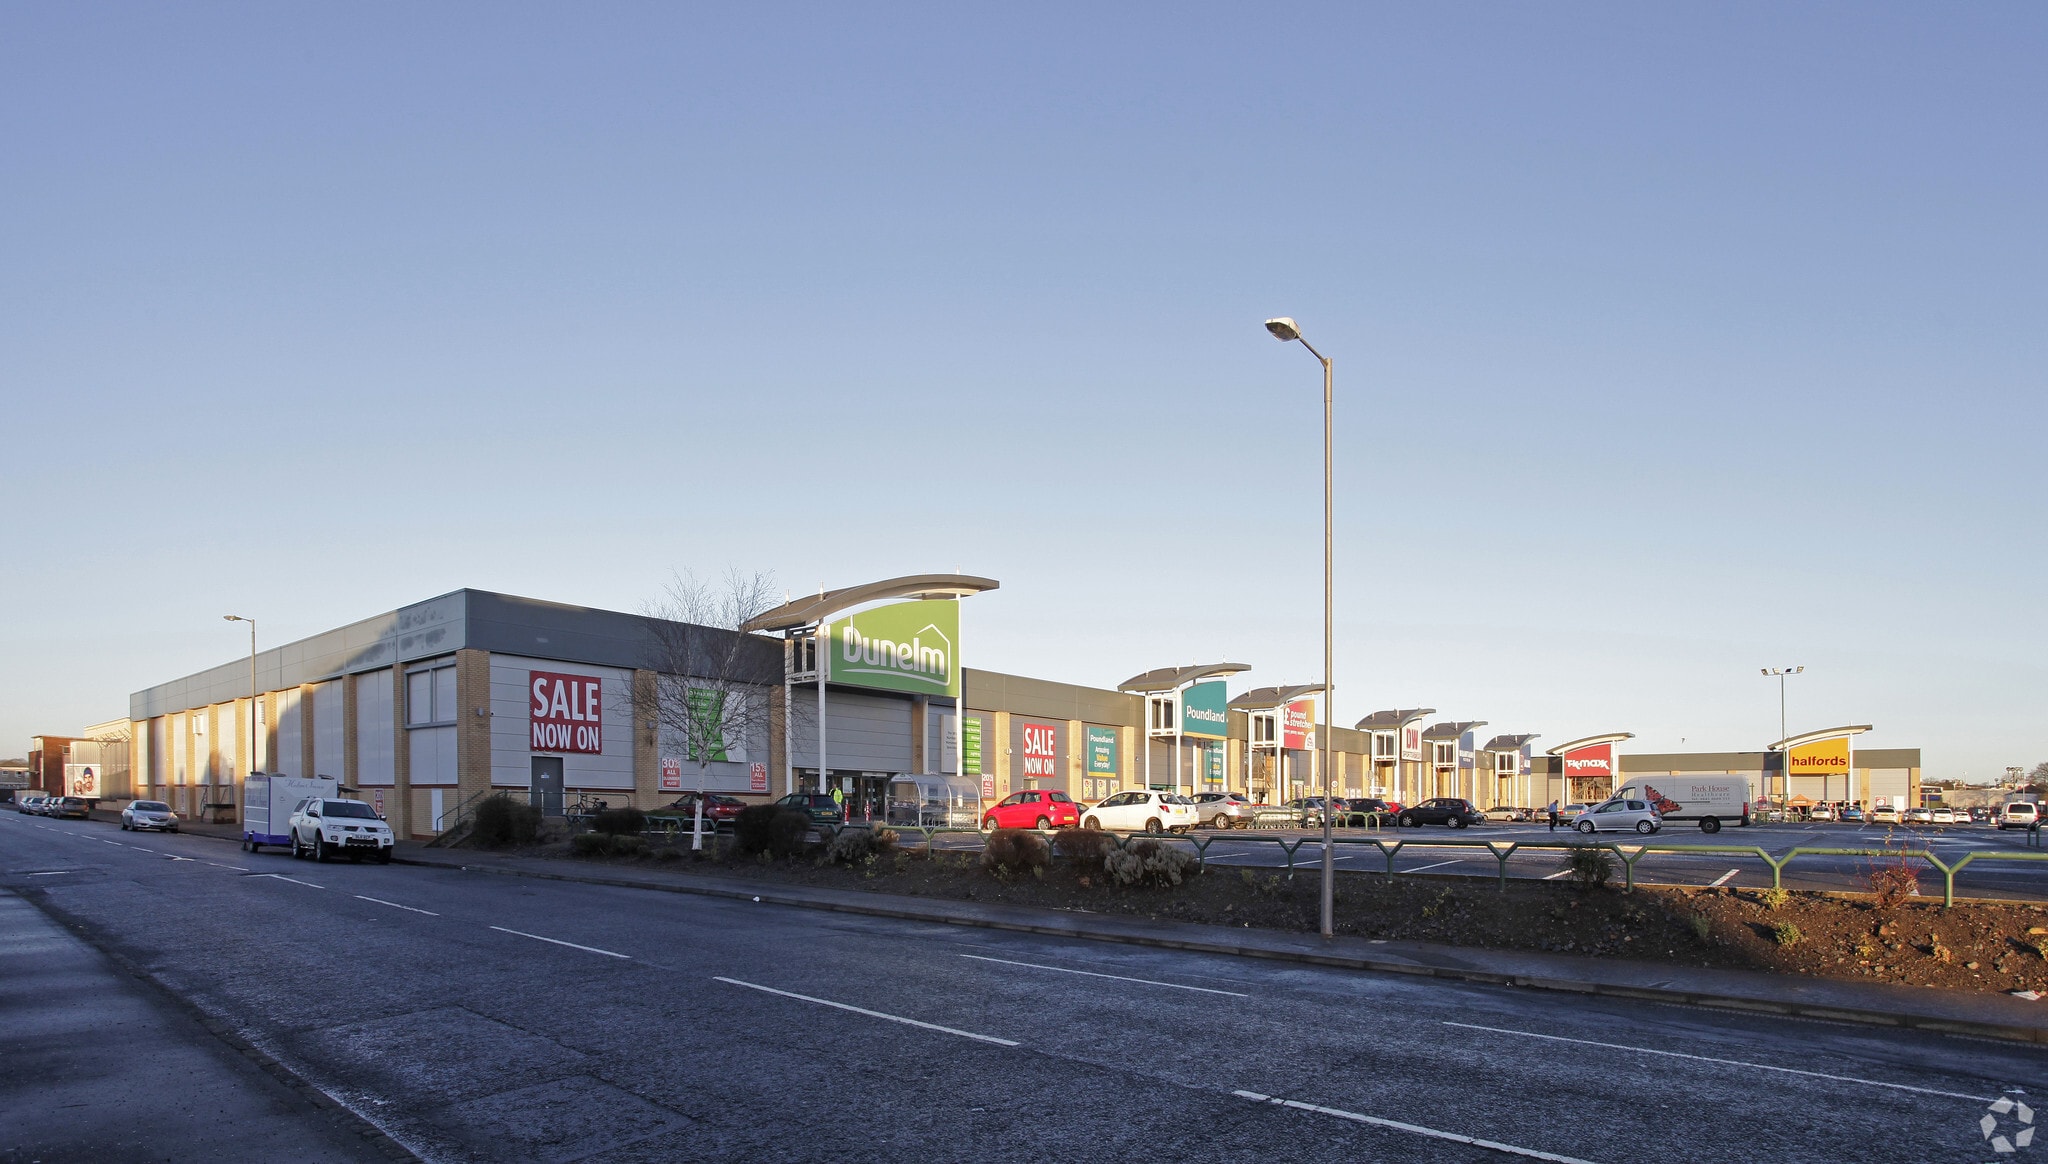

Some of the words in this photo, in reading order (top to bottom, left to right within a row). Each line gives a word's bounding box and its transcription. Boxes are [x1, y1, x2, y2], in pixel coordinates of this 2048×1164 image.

[843, 626, 945, 675] Dunelm
[533, 677, 599, 722] SALE
[1186, 705, 1225, 723] Poundland
[1290, 711, 1307, 720] pound
[1290, 719, 1313, 729] stretcher
[533, 722, 572, 750] NOW
[577, 725, 599, 751] ON
[1024, 727, 1054, 756] SALE
[1090, 734, 1114, 744] Poundland
[1406, 727, 1419, 750] DW
[1024, 756, 1042, 775] NOW
[1043, 758, 1055, 775] ON
[1791, 756, 1847, 766] halfords
